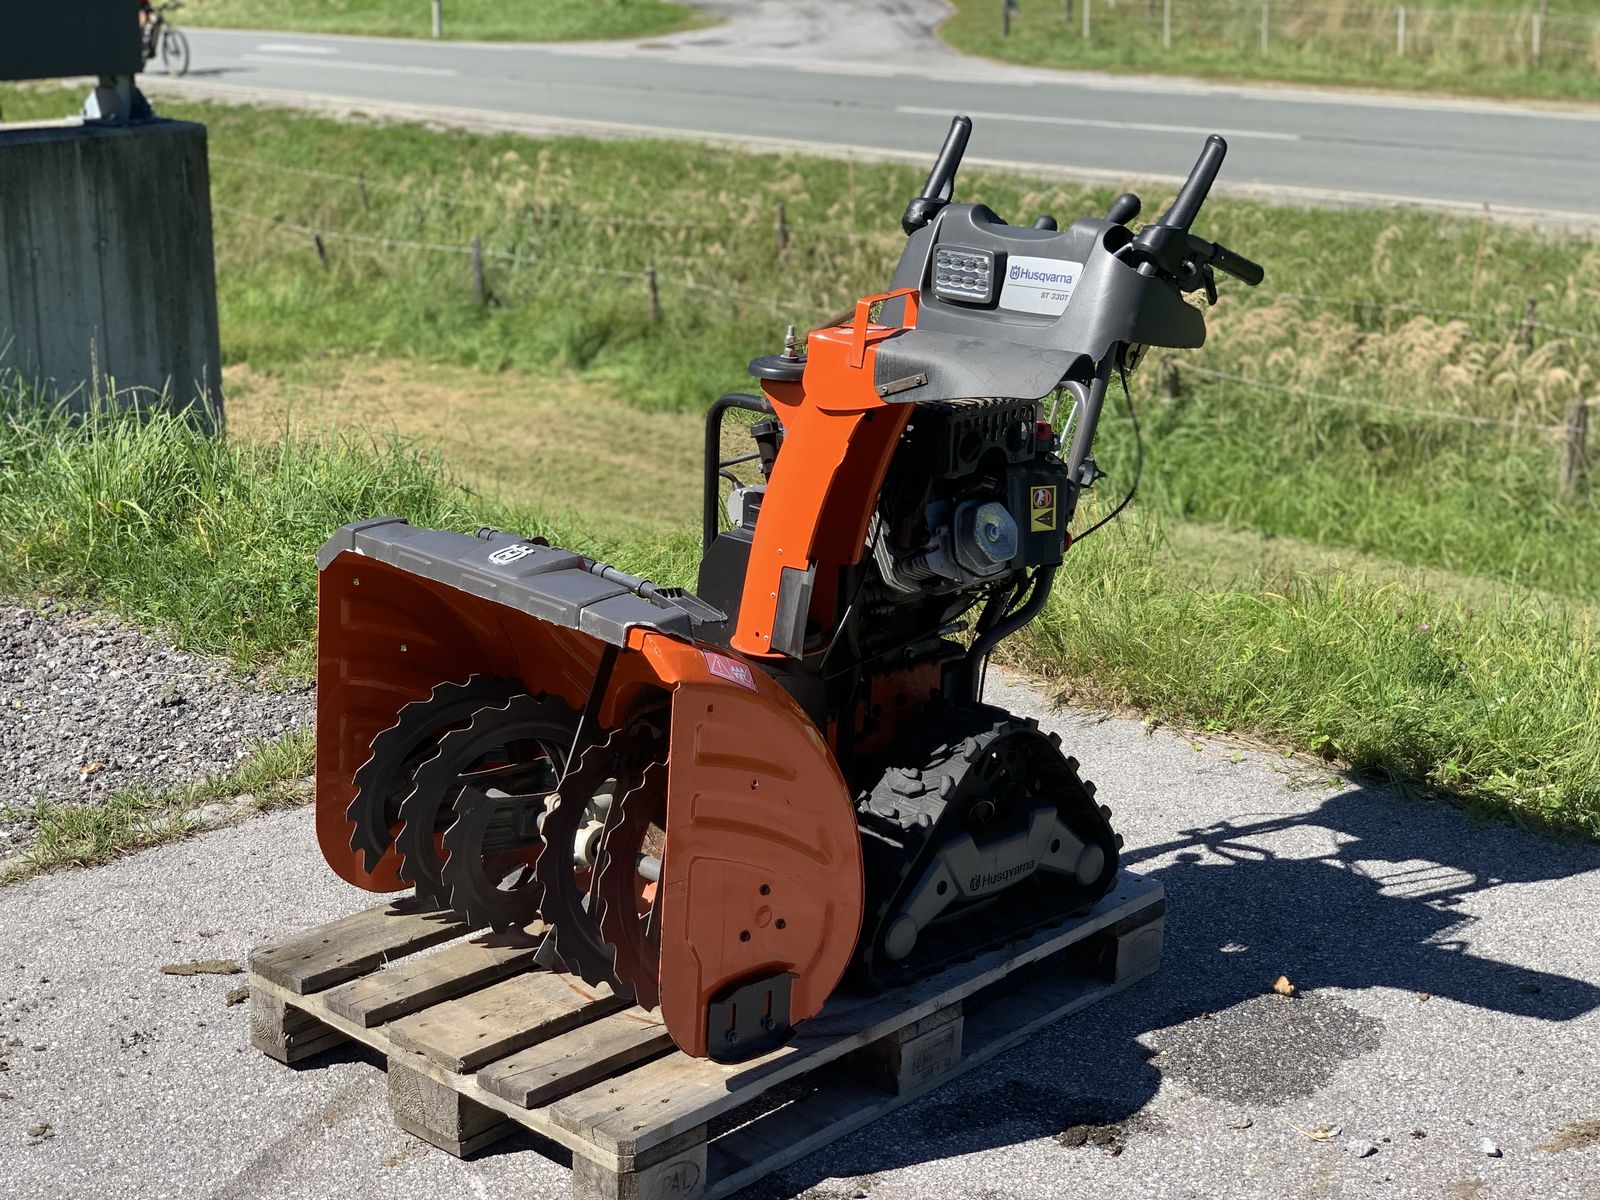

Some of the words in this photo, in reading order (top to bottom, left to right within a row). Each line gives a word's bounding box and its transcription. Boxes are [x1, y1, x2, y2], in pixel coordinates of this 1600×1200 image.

[1020, 267, 1072, 284] Husqvarna
[1040, 291, 1050, 299] ST
[1051, 293, 1069, 301] 330T
[982, 859, 1035, 887] Husqvarna
